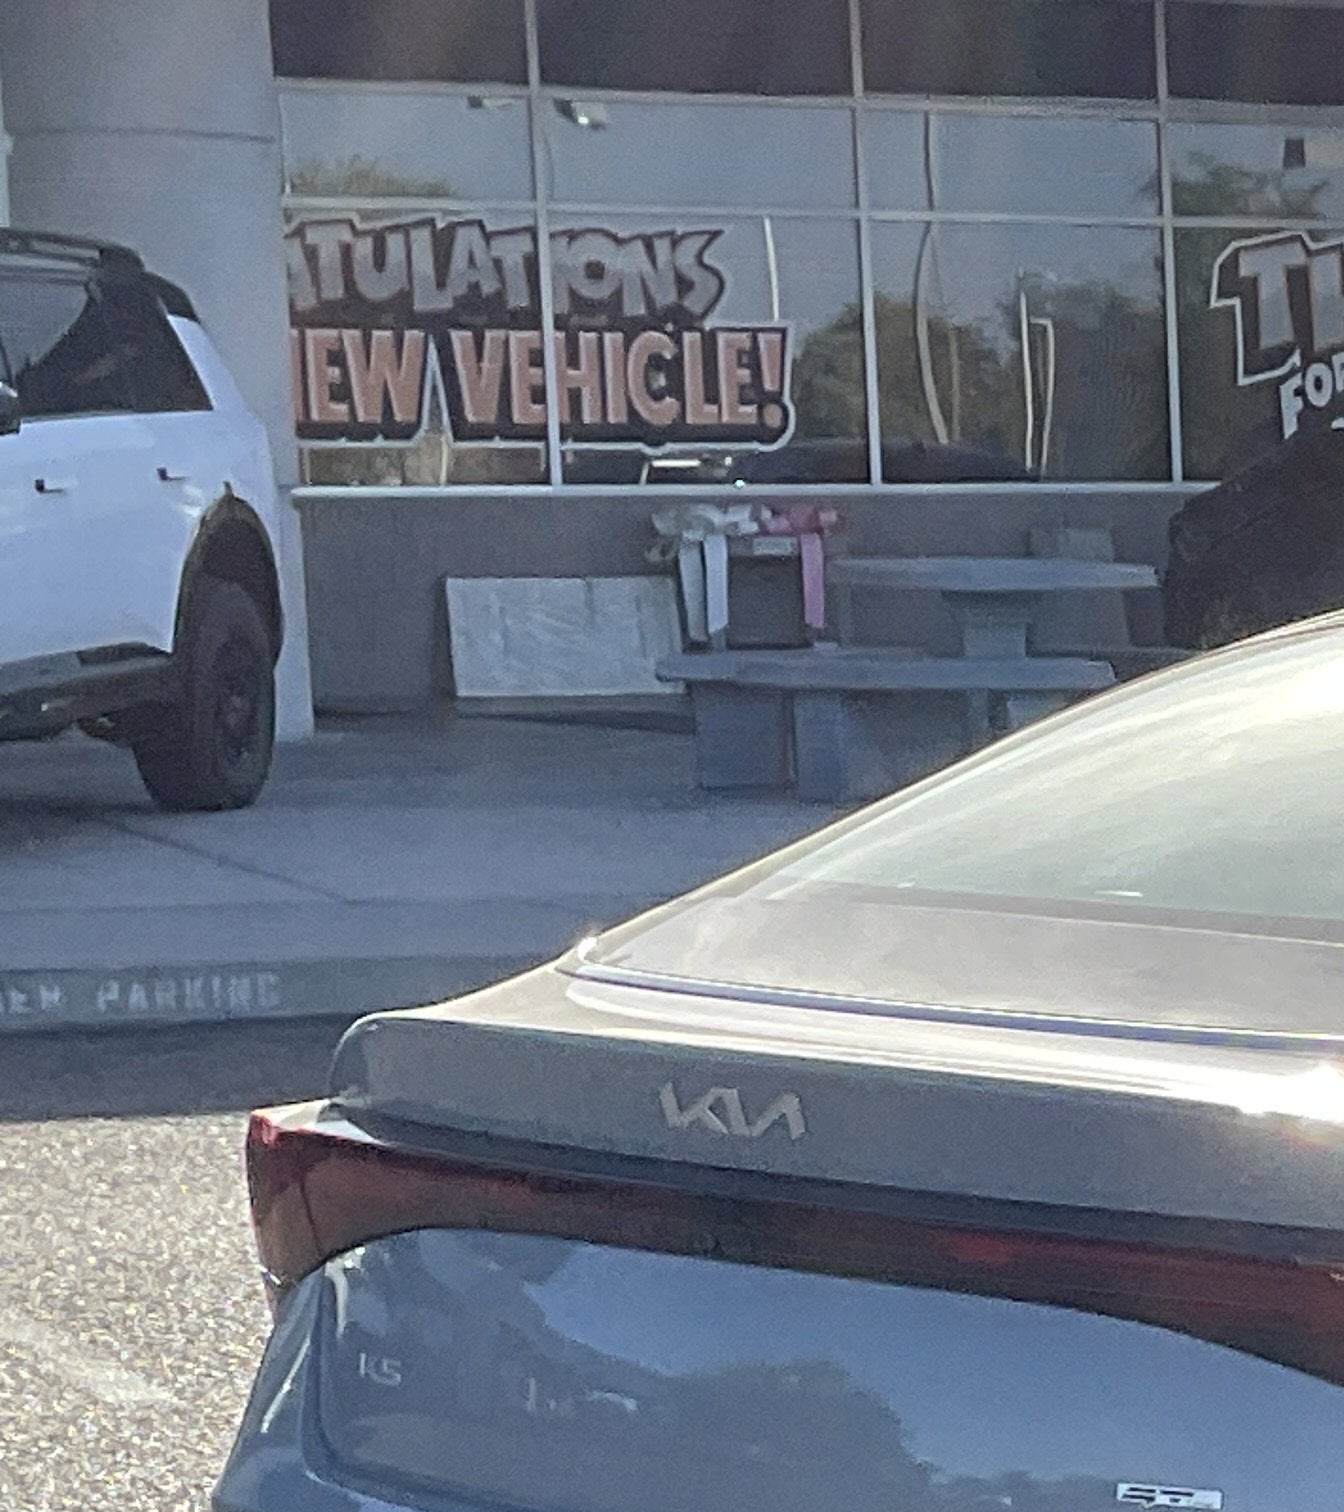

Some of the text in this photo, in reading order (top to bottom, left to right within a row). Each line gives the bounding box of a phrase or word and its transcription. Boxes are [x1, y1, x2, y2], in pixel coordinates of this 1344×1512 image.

[449, 328, 786, 430] VEHICLE!
[97, 970, 280, 1014] PARKING
[658, 1081, 806, 1141] KIA
